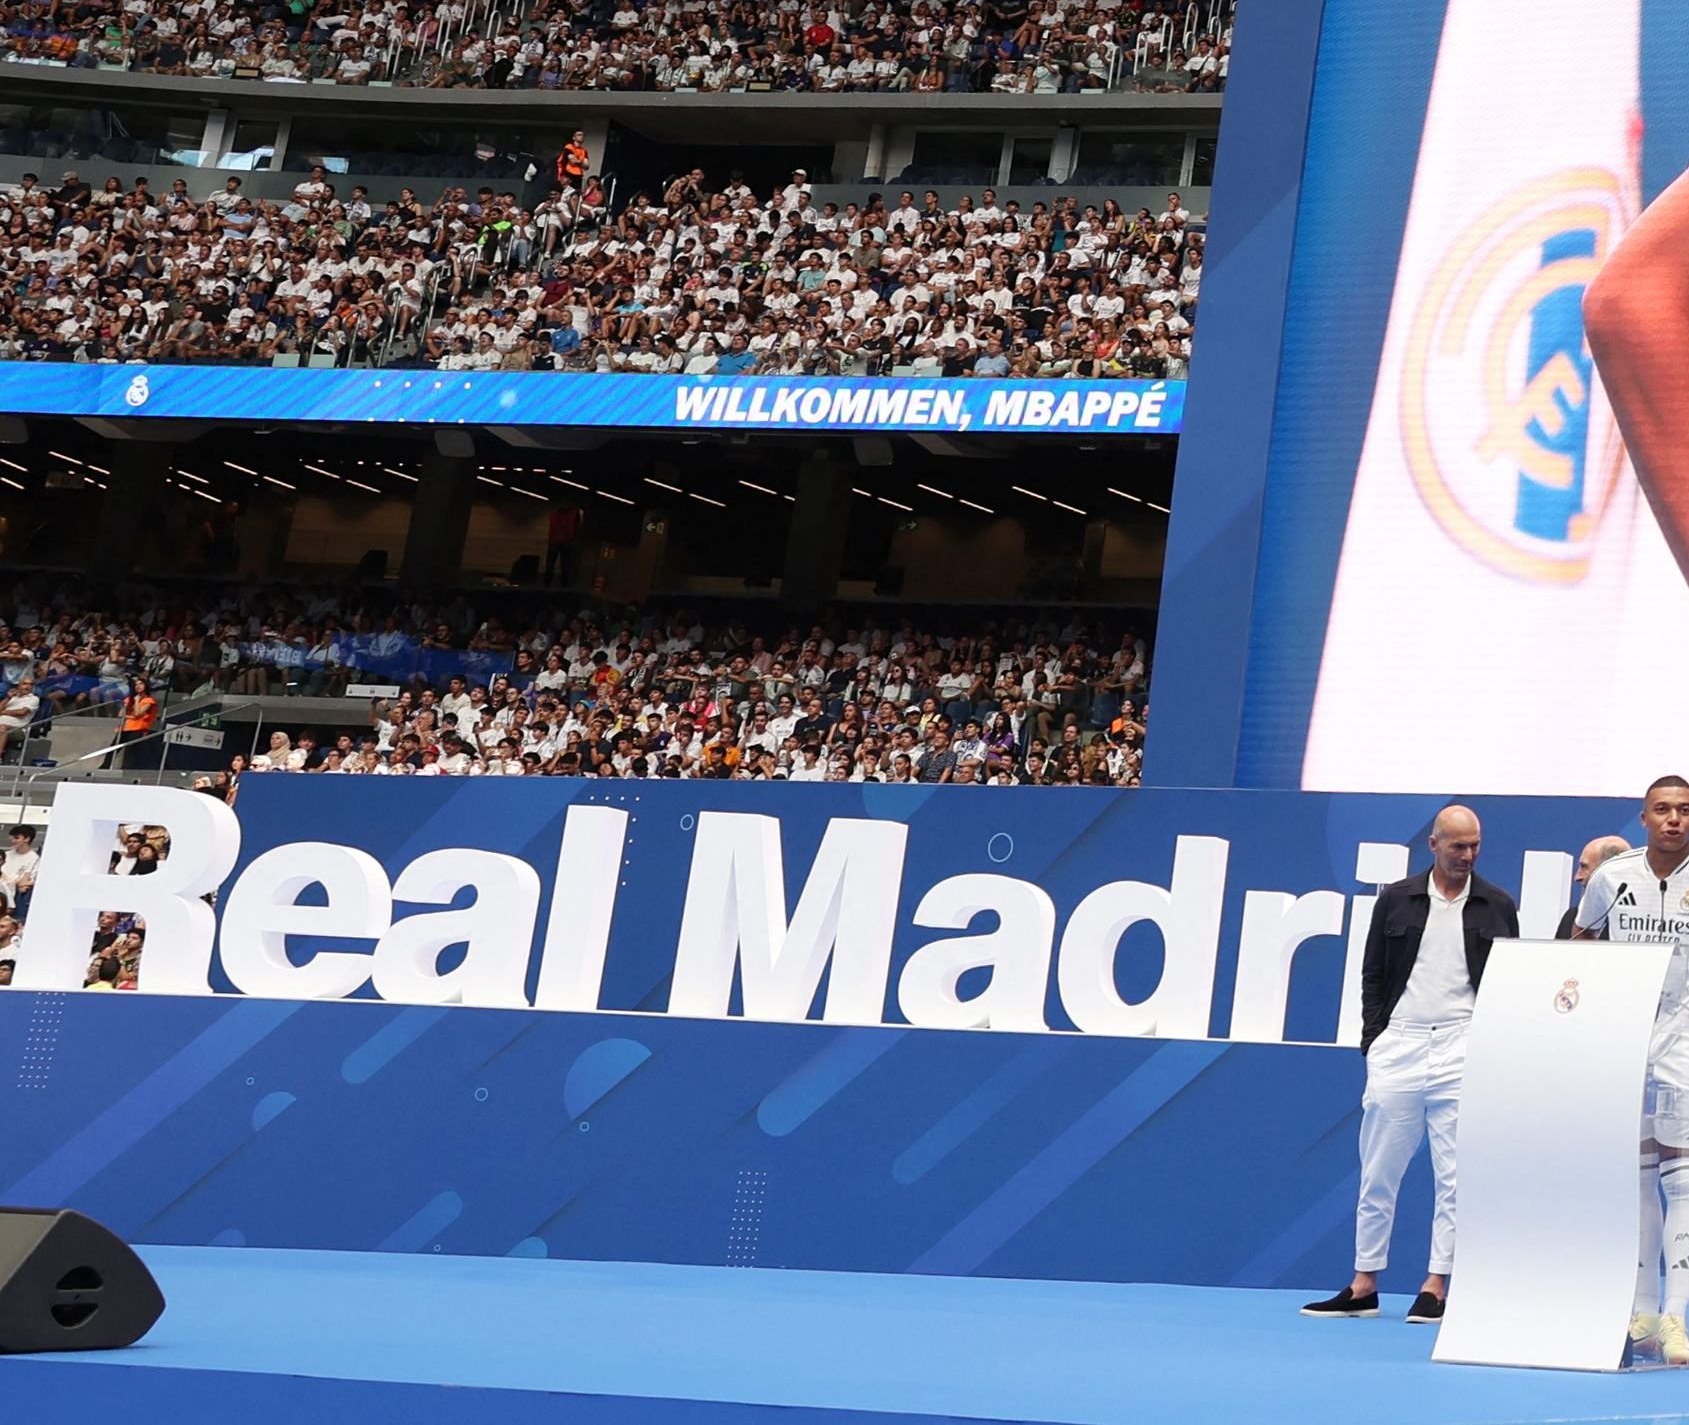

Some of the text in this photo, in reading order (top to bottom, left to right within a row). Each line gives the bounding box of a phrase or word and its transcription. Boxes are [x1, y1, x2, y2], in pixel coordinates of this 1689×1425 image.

[675, 381, 1168, 432] WILLKOMMEN, MBAPPÉ
[18, 781, 630, 1012] Real
